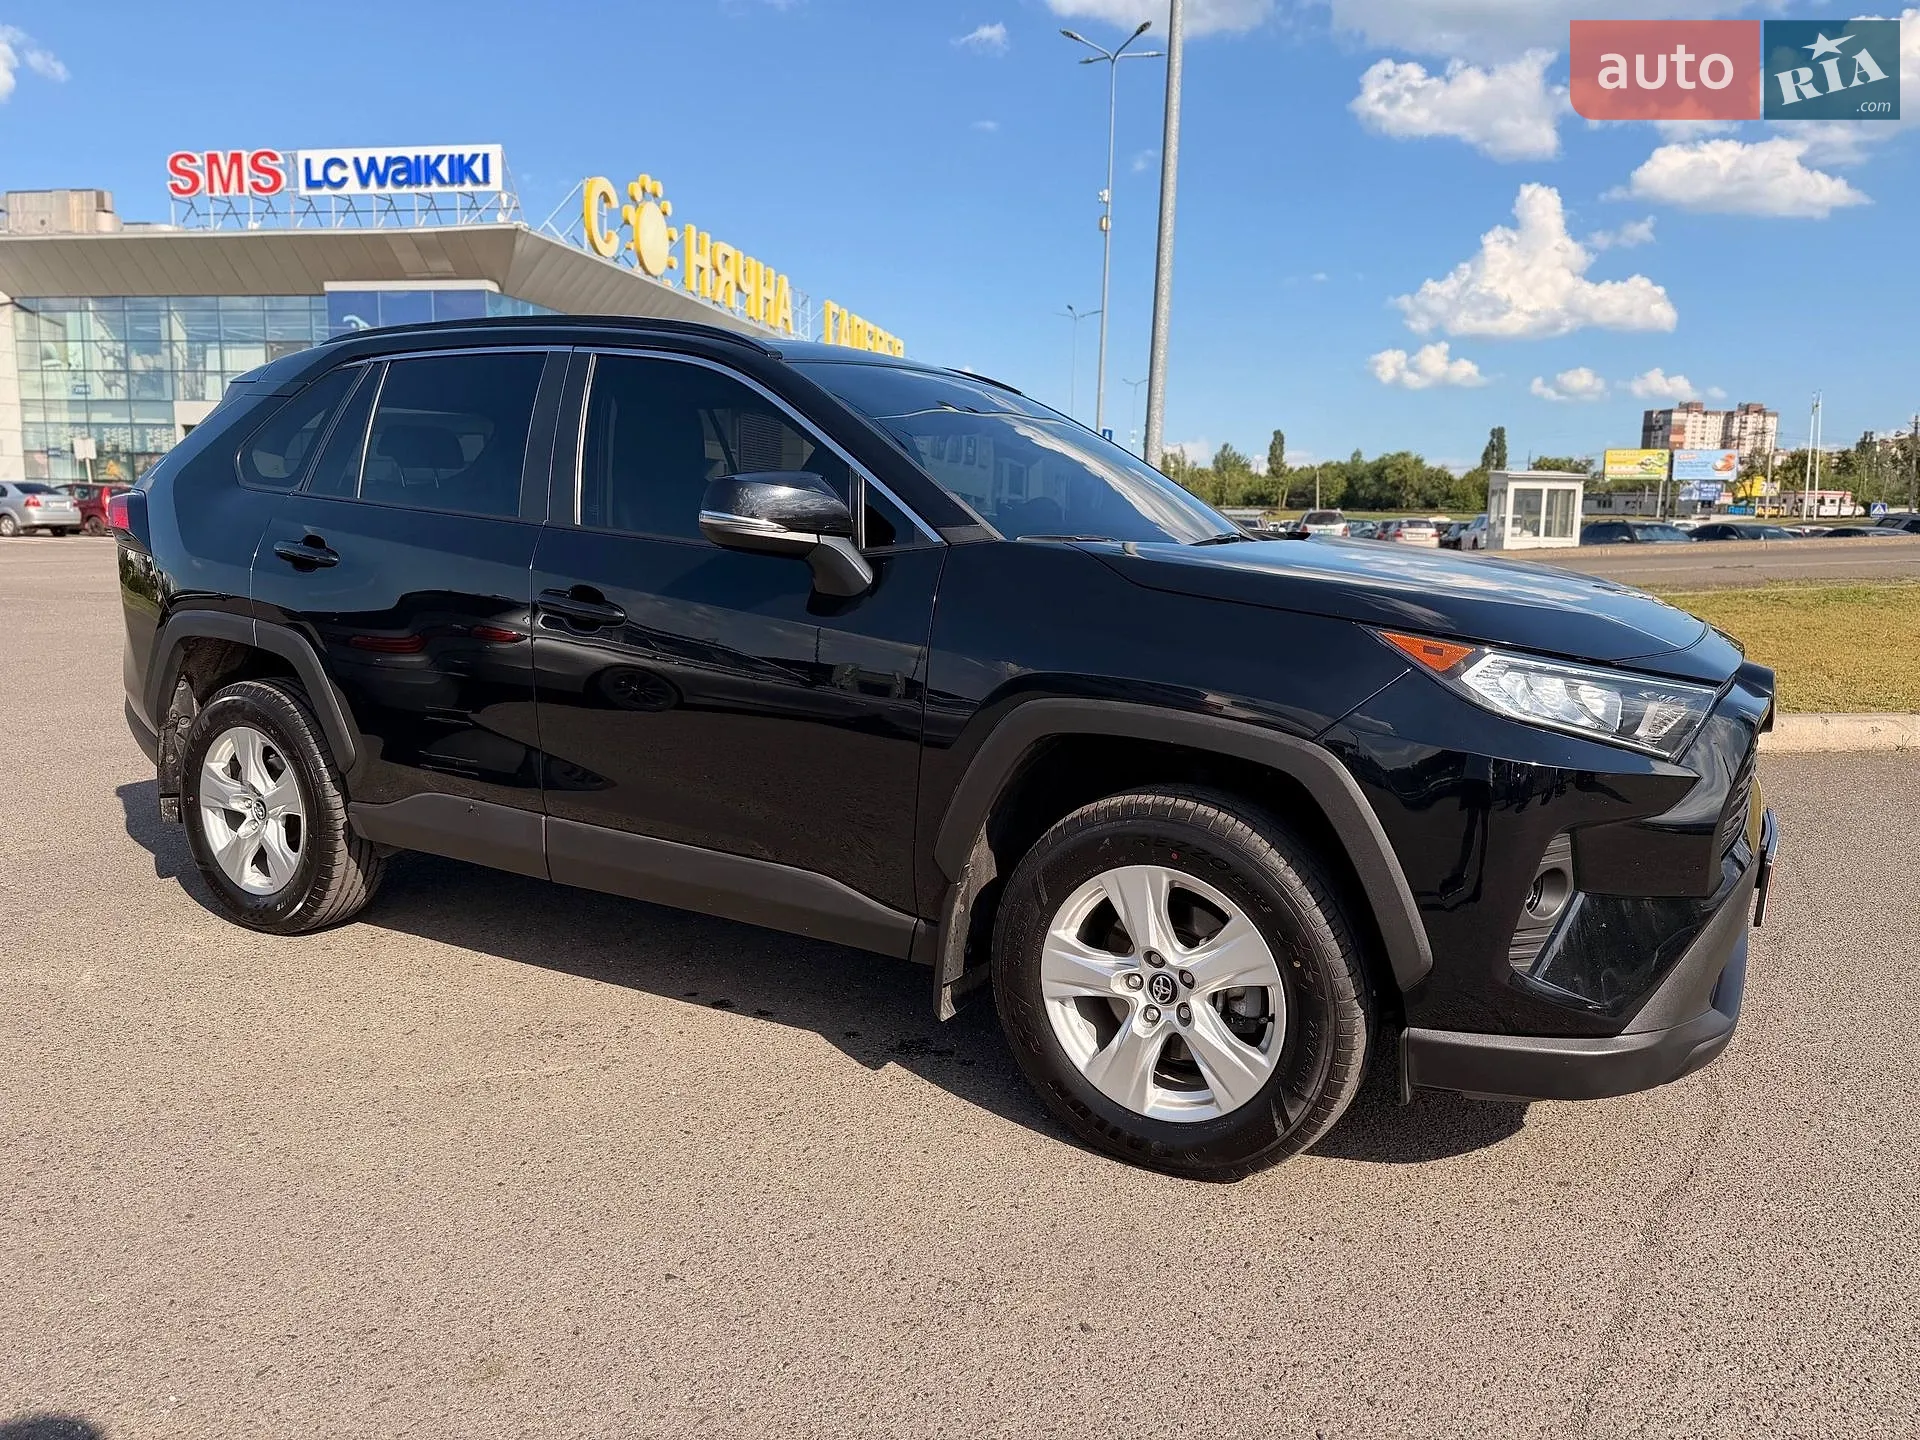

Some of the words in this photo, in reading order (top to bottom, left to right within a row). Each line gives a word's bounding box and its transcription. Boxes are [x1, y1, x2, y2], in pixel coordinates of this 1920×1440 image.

[168, 149, 285, 197] SMS
[305, 157, 349, 190] LC
[583, 173, 794, 334] СОНЯЧНА
